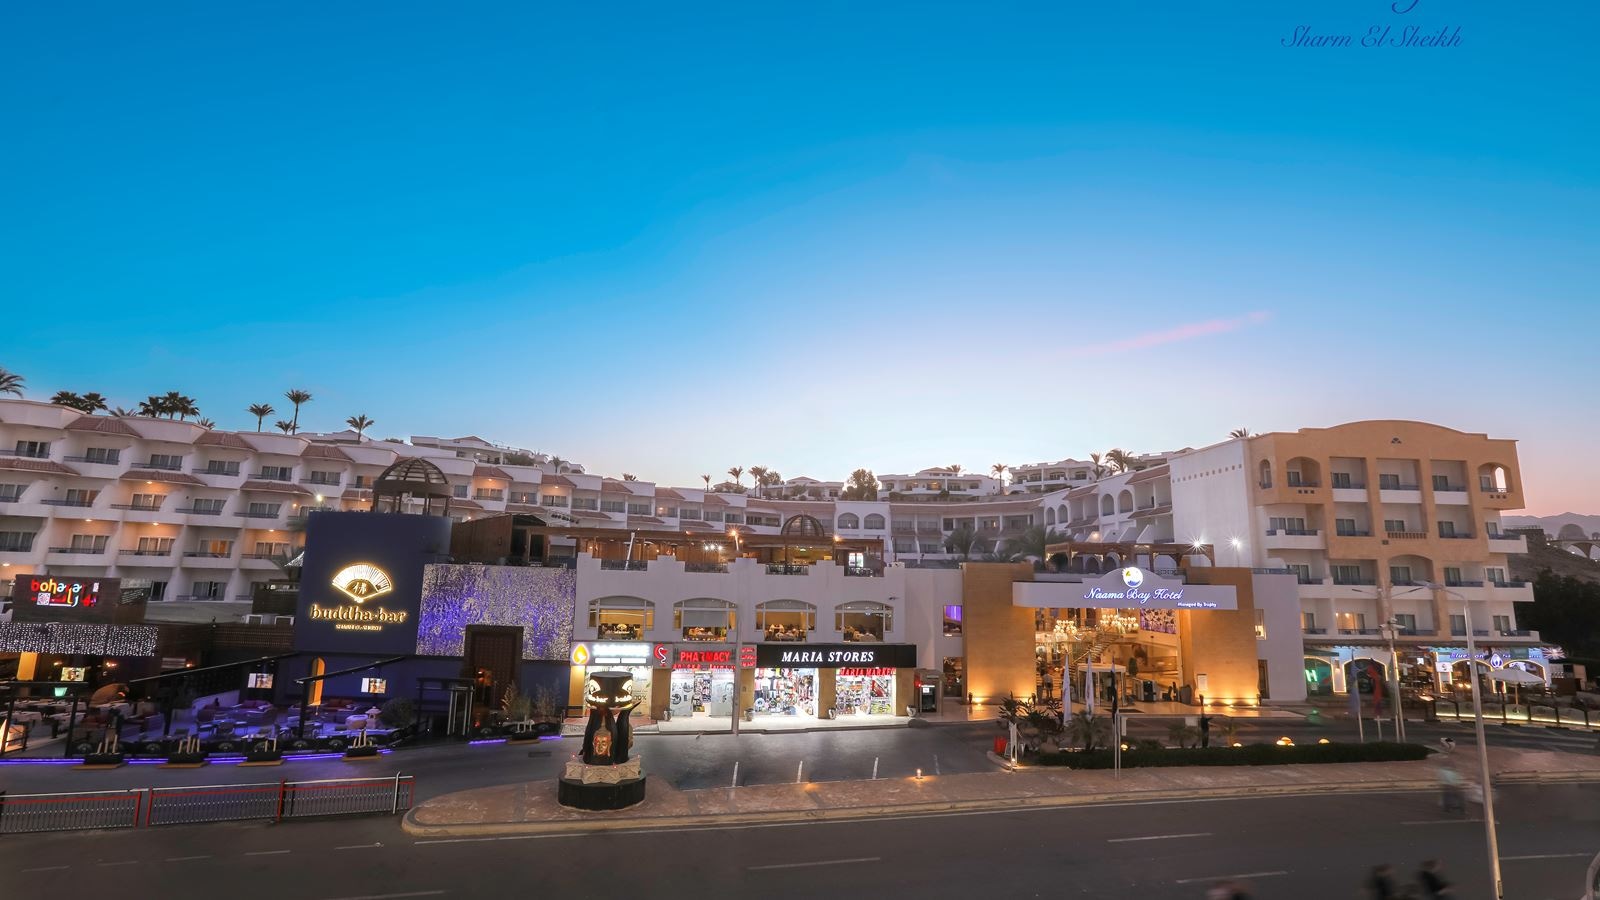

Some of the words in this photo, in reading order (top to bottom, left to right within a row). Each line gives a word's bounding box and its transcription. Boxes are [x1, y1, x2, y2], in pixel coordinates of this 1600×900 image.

[1084, 588, 1125, 600] Naama
[1126, 588, 1151, 604] Bay
[1152, 588, 1184, 600] Hotel
[680, 650, 731, 662] PHARMACY
[782, 652, 823, 663] MARIA
[828, 651, 875, 662] STORES
